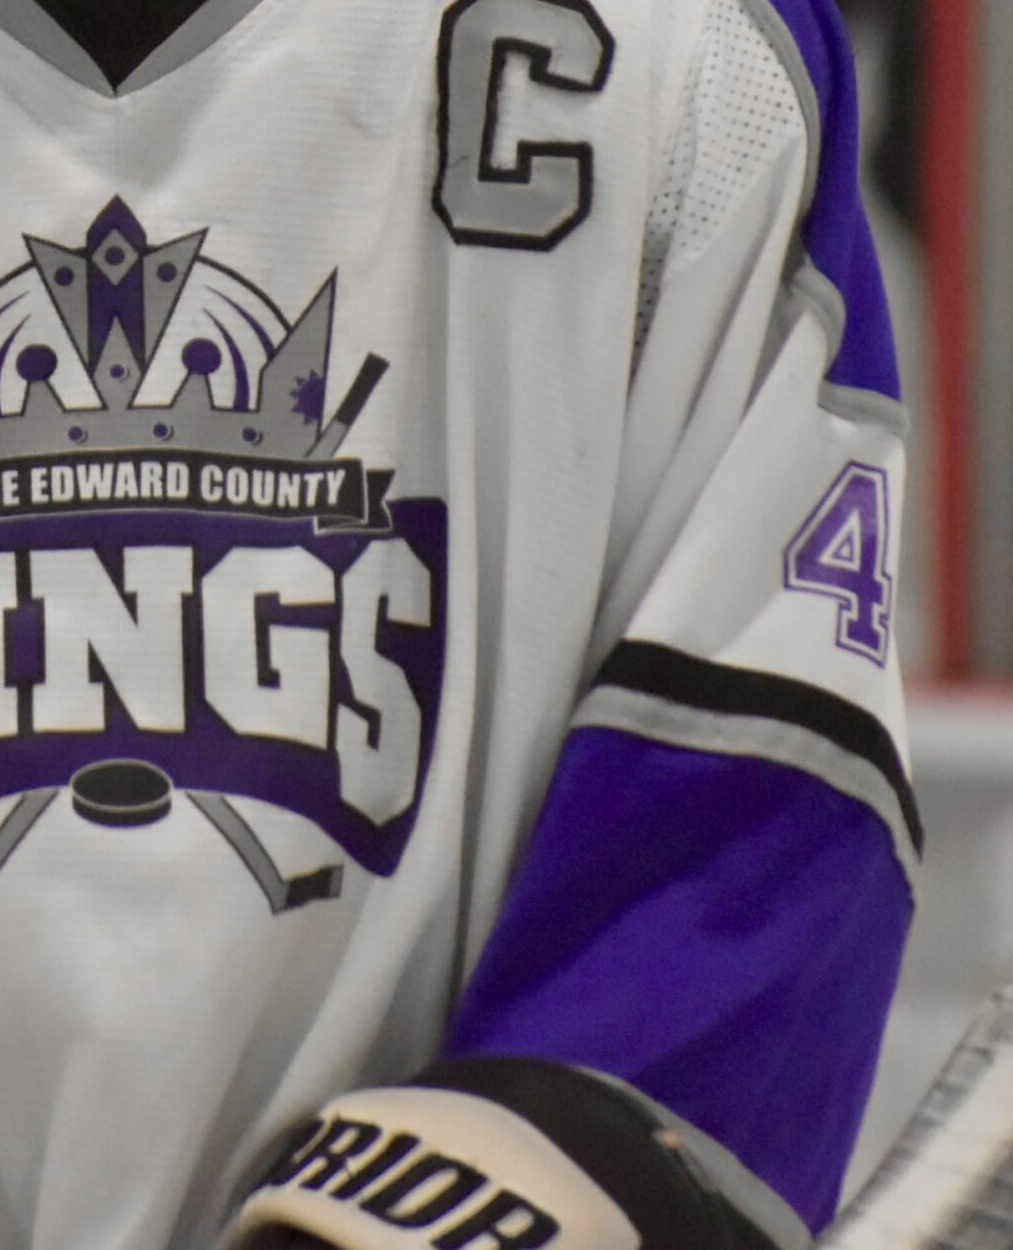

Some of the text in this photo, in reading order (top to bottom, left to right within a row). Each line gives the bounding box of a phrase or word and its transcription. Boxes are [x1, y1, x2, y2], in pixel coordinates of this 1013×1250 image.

[30, 461, 189, 504] EDWARD
[200, 464, 347, 509] COUNTY
[783, 460, 892, 670] 4
